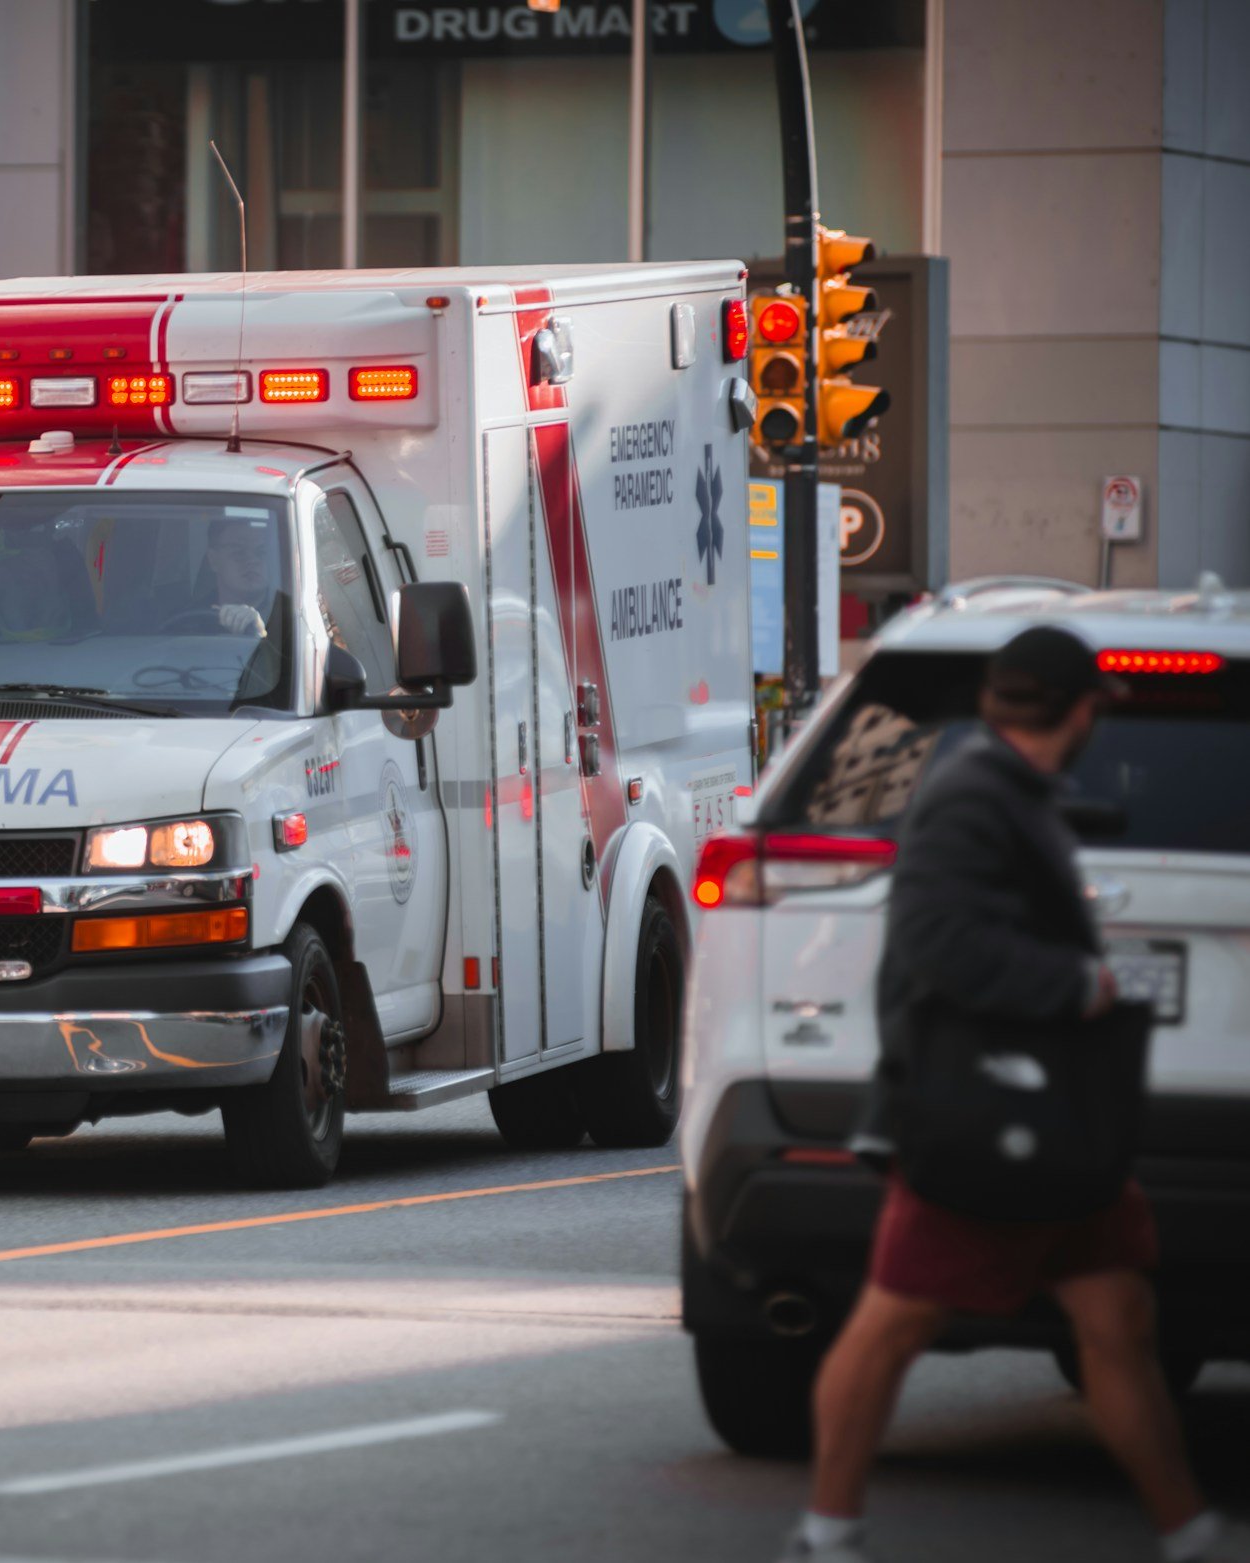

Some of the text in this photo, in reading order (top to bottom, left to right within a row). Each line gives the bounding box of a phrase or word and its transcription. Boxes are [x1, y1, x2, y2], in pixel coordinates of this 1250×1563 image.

[395, 6, 538, 40] DRUG
[611, 420, 675, 463] EMERGENCY
[614, 467, 674, 511] PARAMEDIC
[611, 578, 683, 642] AMBULANCE
